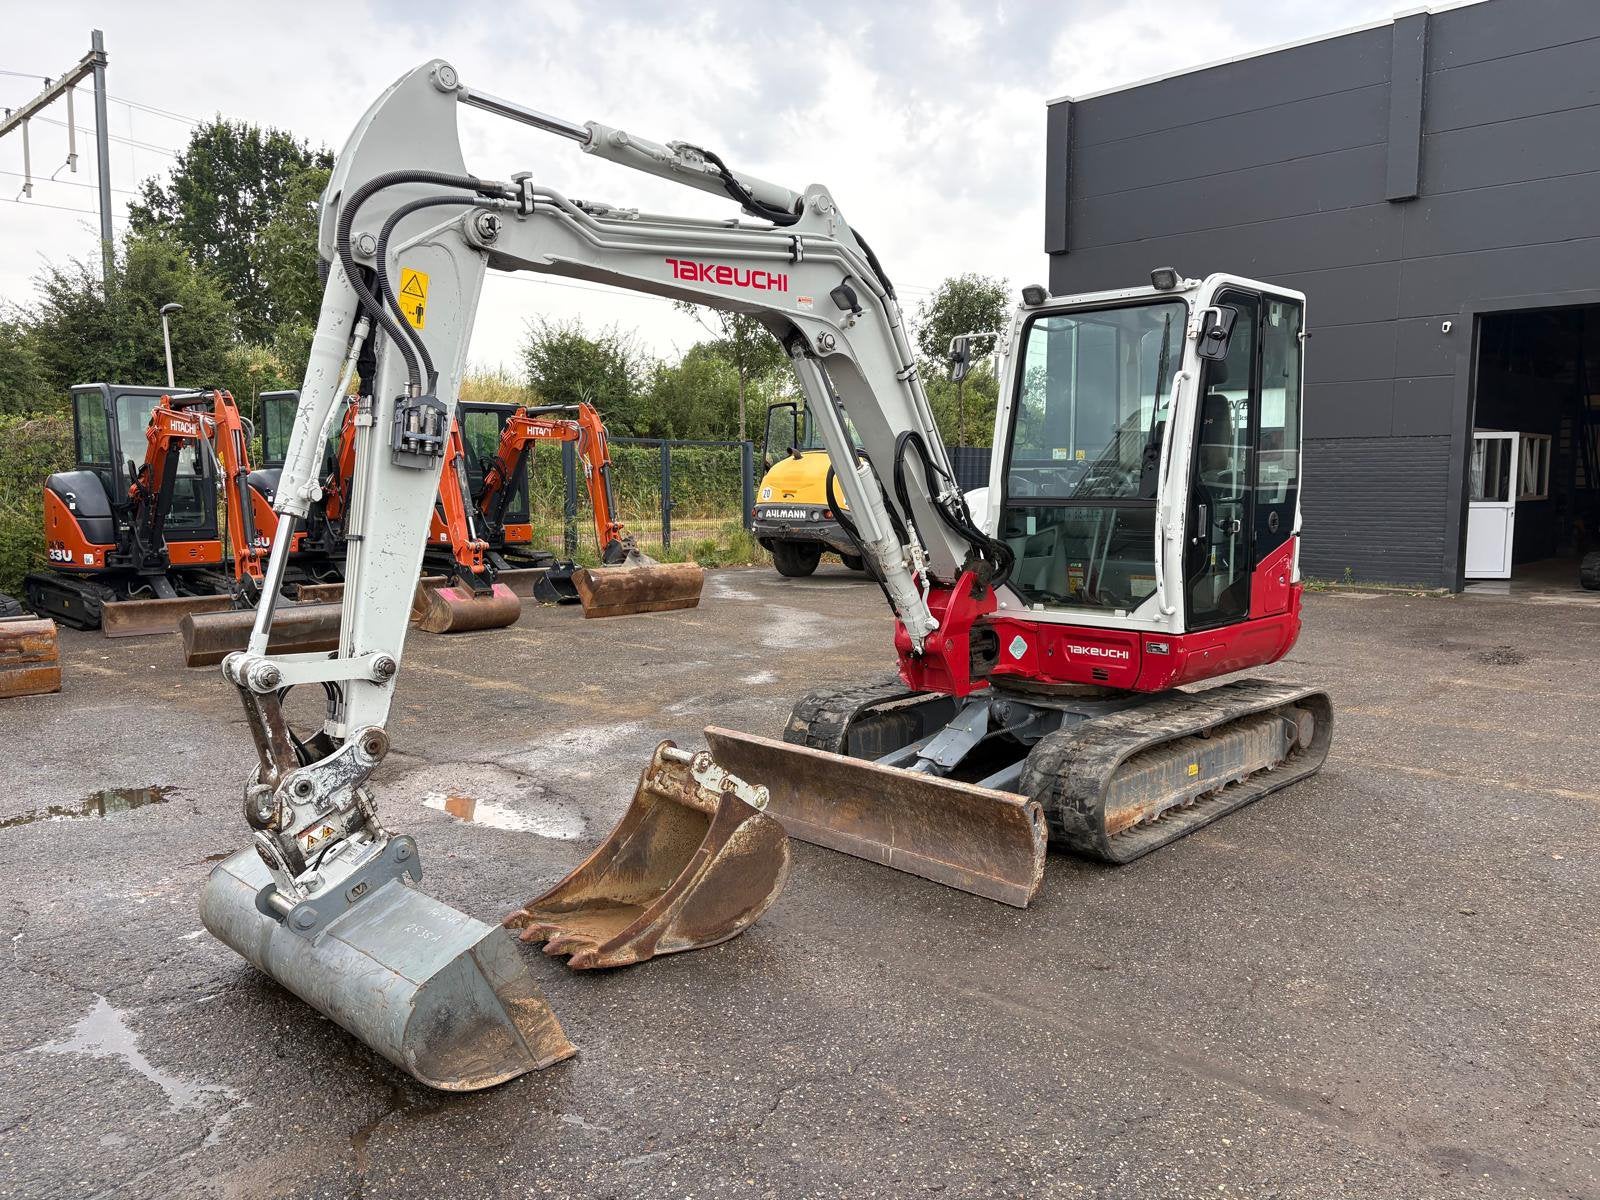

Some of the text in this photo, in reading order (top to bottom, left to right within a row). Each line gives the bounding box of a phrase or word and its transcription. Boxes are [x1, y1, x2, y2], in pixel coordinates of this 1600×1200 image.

[666, 258, 788, 292] TAKEUCHI
[170, 420, 197, 434] HITACHI
[763, 490, 771, 498] 20
[49, 549, 73, 562] 33U
[1067, 645, 1129, 660] TAKEUCHI
